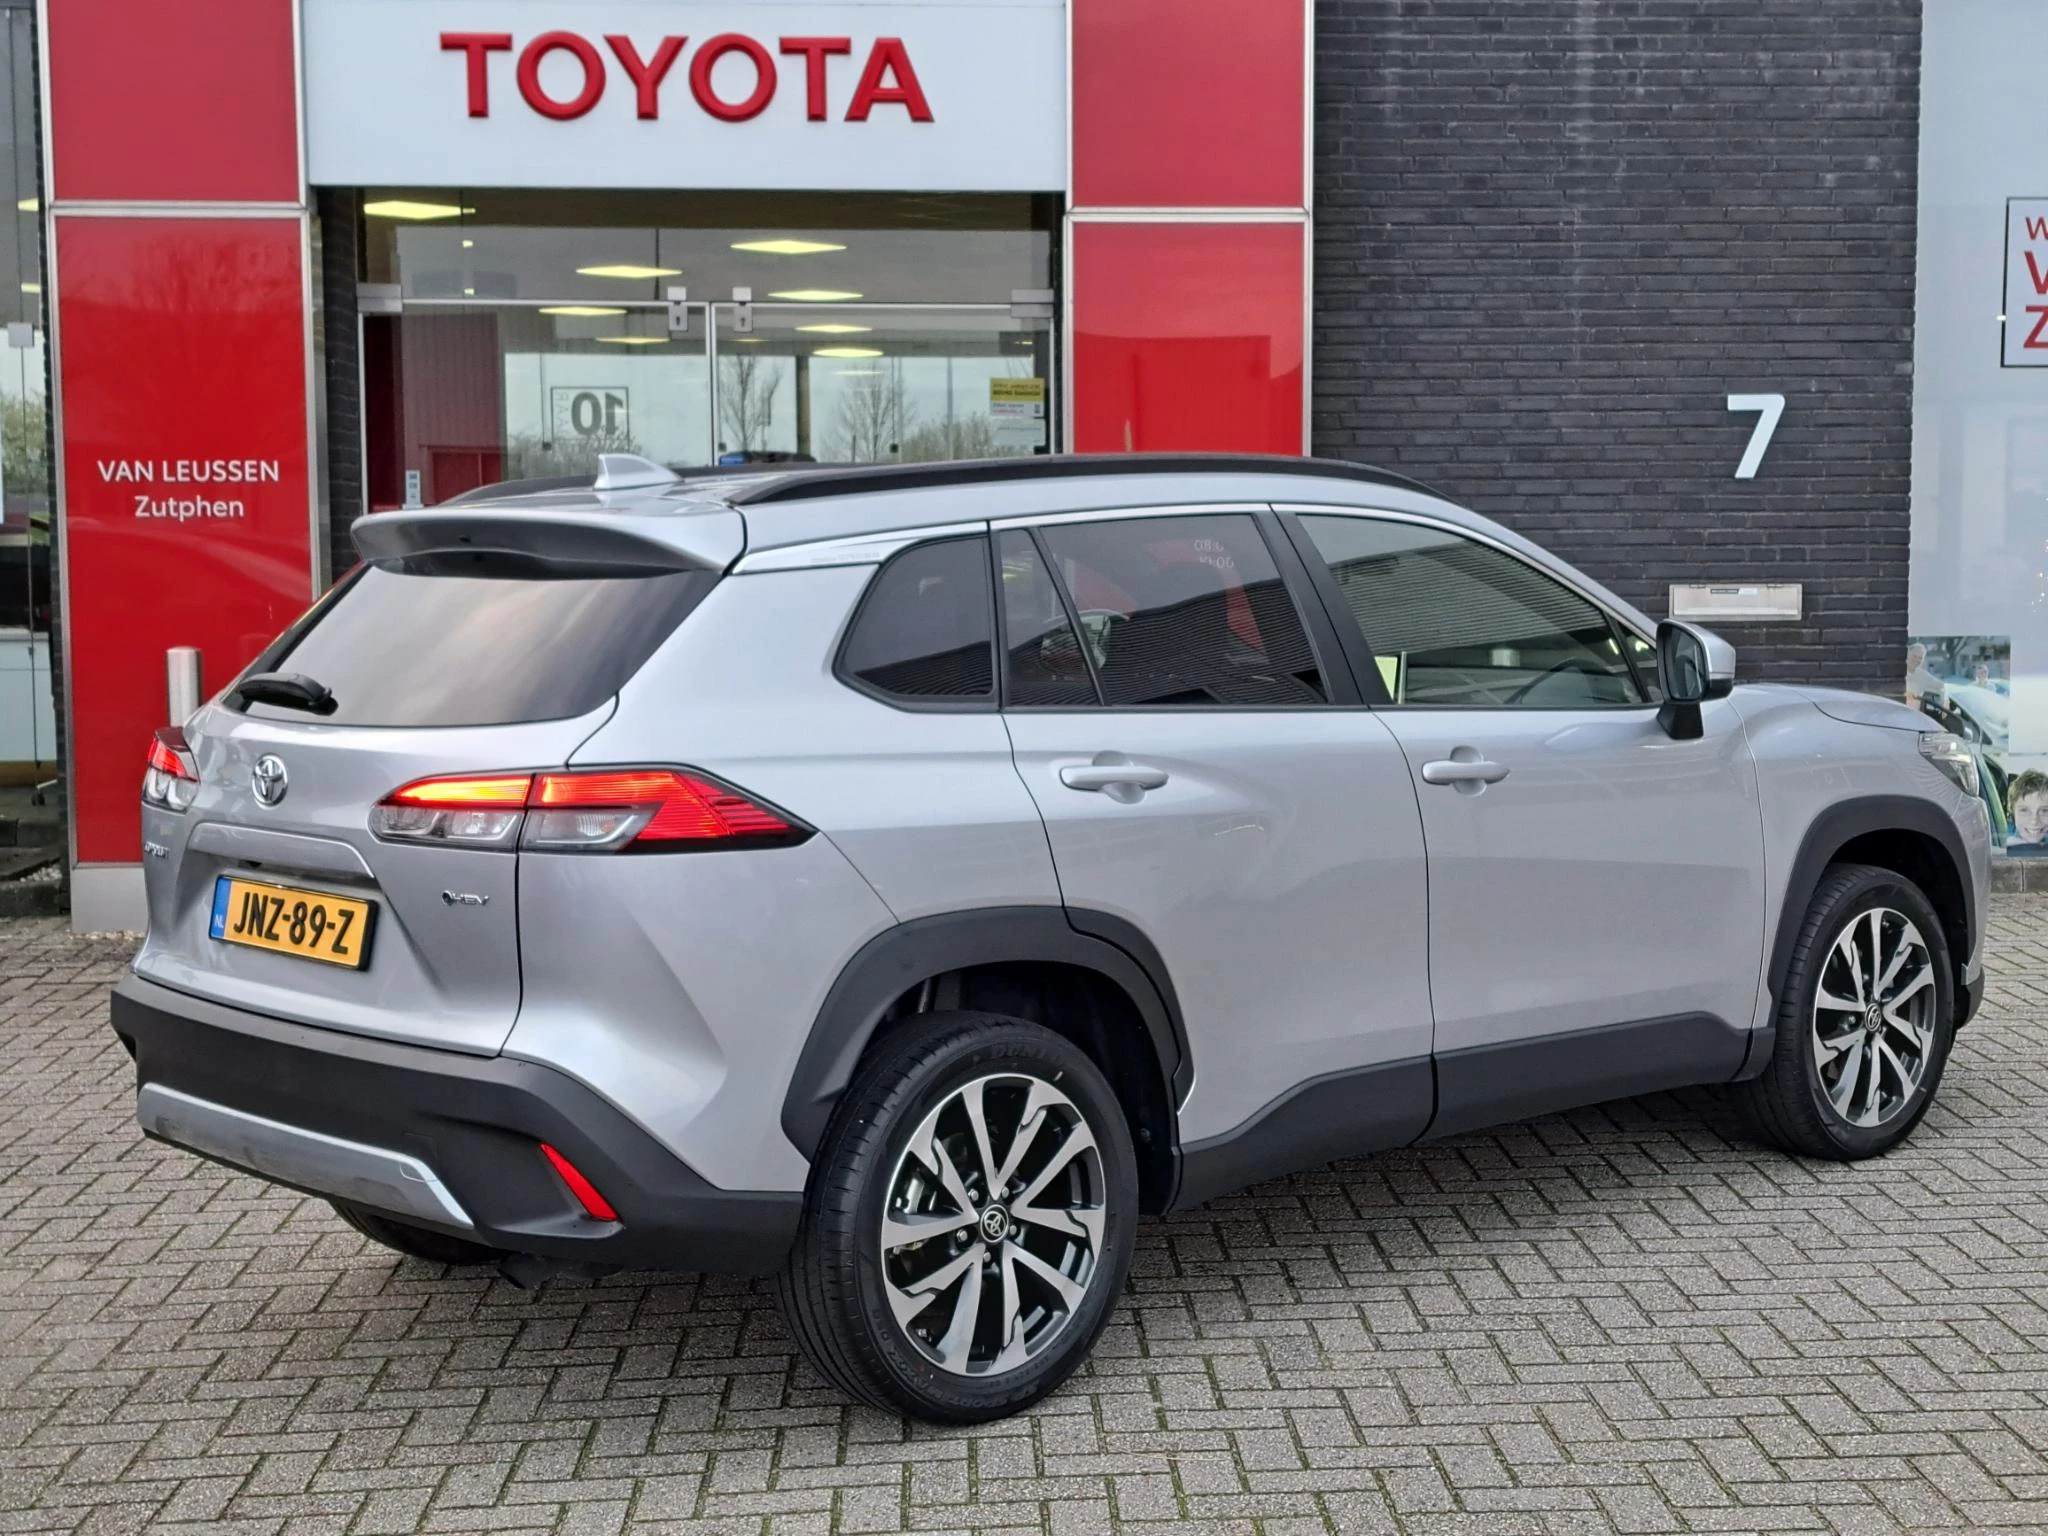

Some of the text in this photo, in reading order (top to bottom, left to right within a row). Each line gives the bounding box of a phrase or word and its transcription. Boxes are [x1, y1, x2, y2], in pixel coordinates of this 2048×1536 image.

[440, 30, 935, 123] TOYOTA
[2025, 216, 2048, 240] W
[2024, 251, 2048, 294] V
[2023, 305, 2048, 348] Z
[1727, 393, 1786, 479] 7
[97, 460, 279, 482] VAN LEUSSEN
[134, 495, 244, 522] Zutphen
[214, 914, 224, 928] NL
[233, 891, 355, 955] JNZ-89-Z
